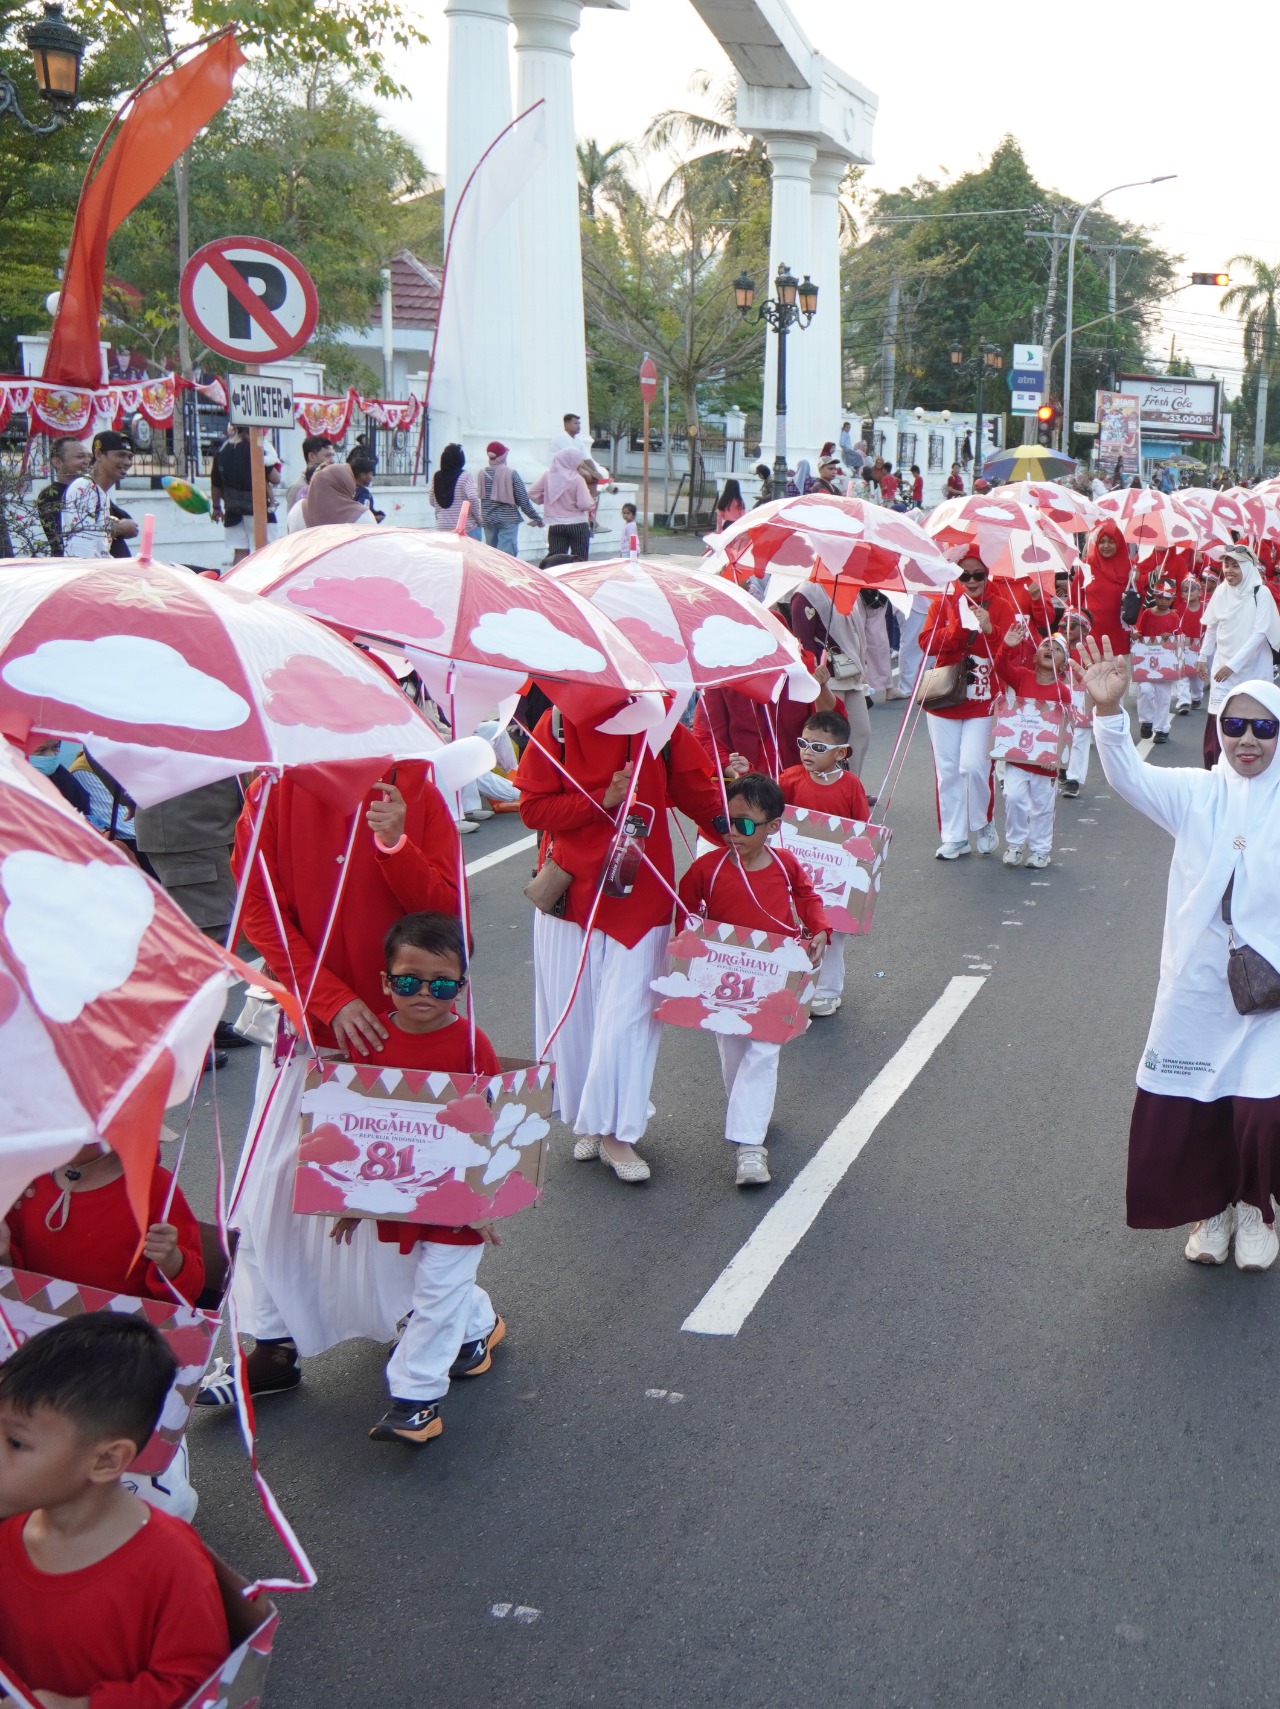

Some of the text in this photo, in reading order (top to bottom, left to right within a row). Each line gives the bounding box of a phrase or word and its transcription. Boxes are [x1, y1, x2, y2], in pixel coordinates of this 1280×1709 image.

[226, 259, 287, 340] P
[1017, 376, 1036, 385] atm
[240, 384, 284, 419] 50 METER
[1141, 394, 1169, 407] Fresh
[1171, 396, 1193, 411] Cola
[785, 843, 844, 867] DIRGAHAYU
[706, 949, 780, 976] DIRGAHAYU
[739, 968, 765, 977] INDONESIA
[714, 971, 756, 1000] 81
[340, 1112, 446, 1140] DIRGAHAYU
[359, 1132, 427, 1144] REPUBLIK INDONESIA
[358, 1140, 416, 1181] 81
